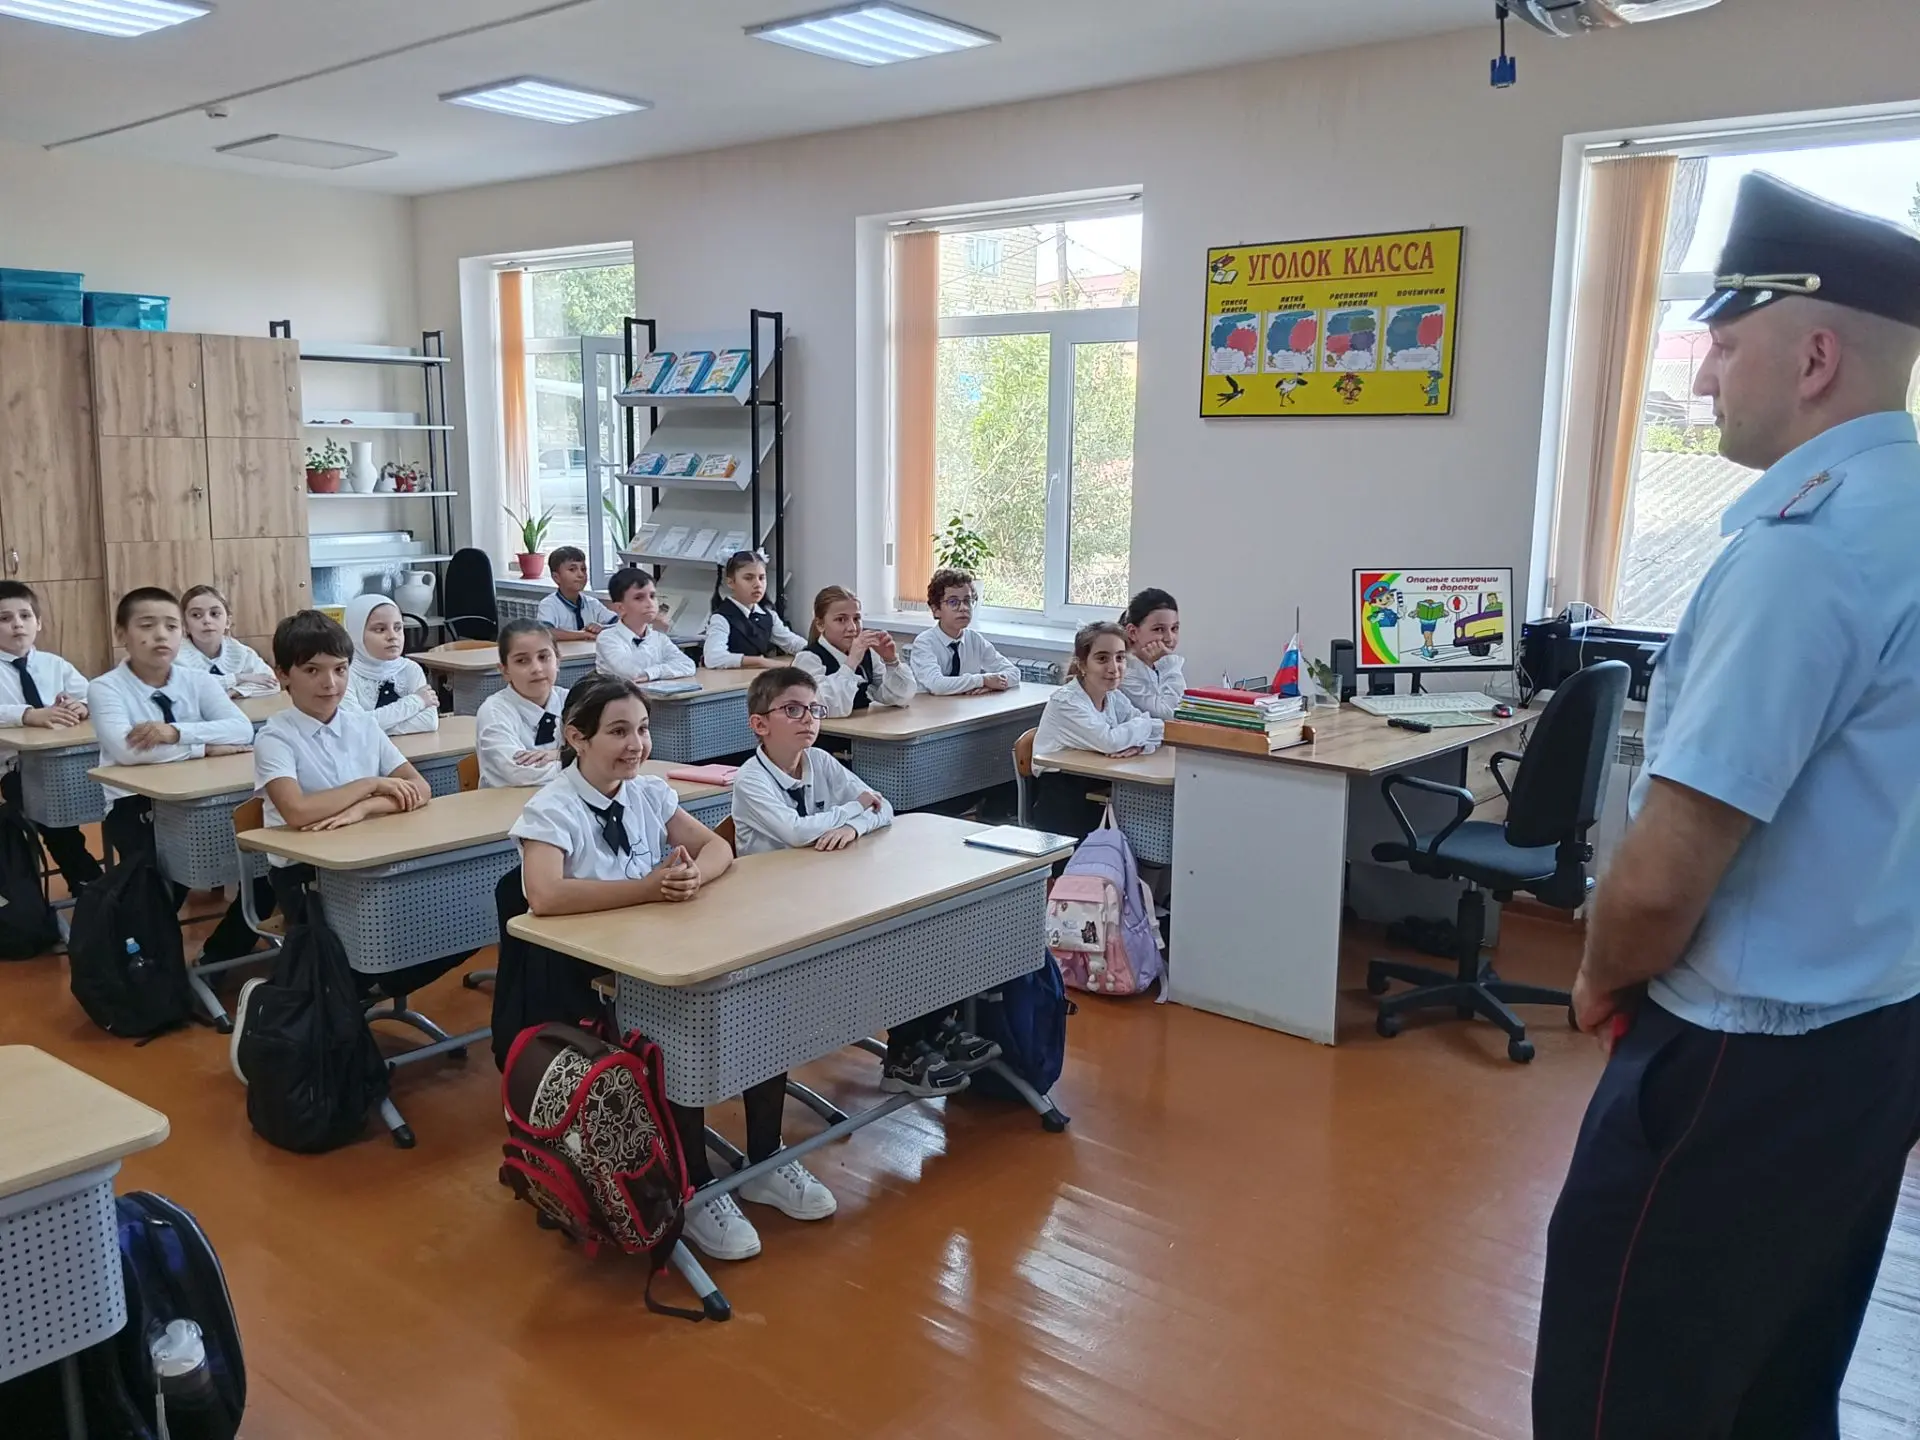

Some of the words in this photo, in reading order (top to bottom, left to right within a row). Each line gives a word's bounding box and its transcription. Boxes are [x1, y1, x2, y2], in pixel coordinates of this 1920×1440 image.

[1248, 249, 1332, 281] УГОЛОК
[1343, 241, 1435, 275] КЛАССА
[1406, 575, 1449, 584] Опасные
[1451, 576, 1499, 584] ситуации
[1440, 584, 1479, 592] дорогах
